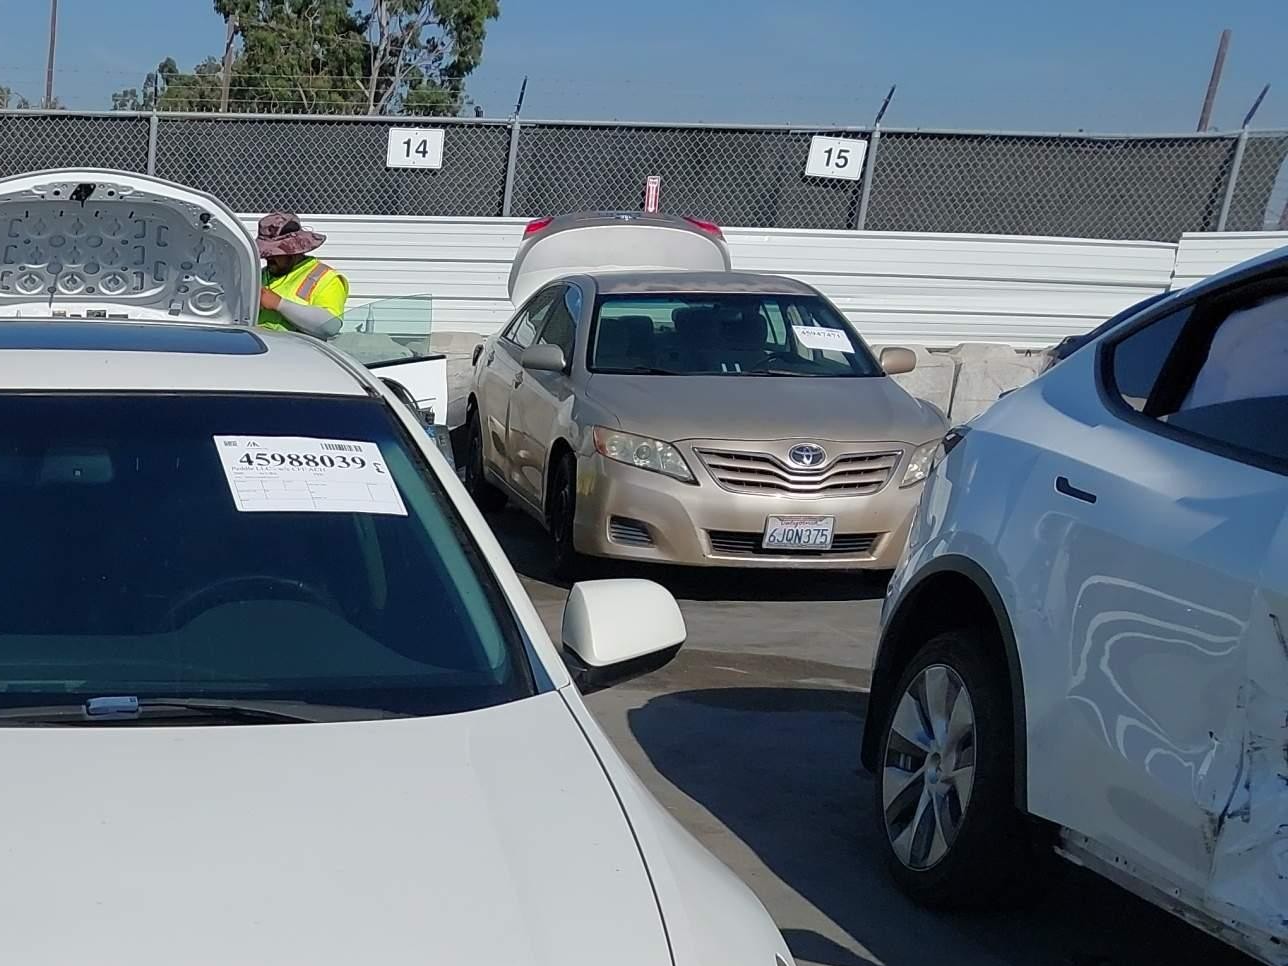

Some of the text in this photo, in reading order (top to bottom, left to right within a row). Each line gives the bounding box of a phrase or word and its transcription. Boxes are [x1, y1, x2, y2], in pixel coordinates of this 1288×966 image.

[403, 138, 429, 158] 14
[824, 147, 850, 169] 15
[239, 452, 367, 470] 45988039
[768, 528, 829, 545] 6JQN375
